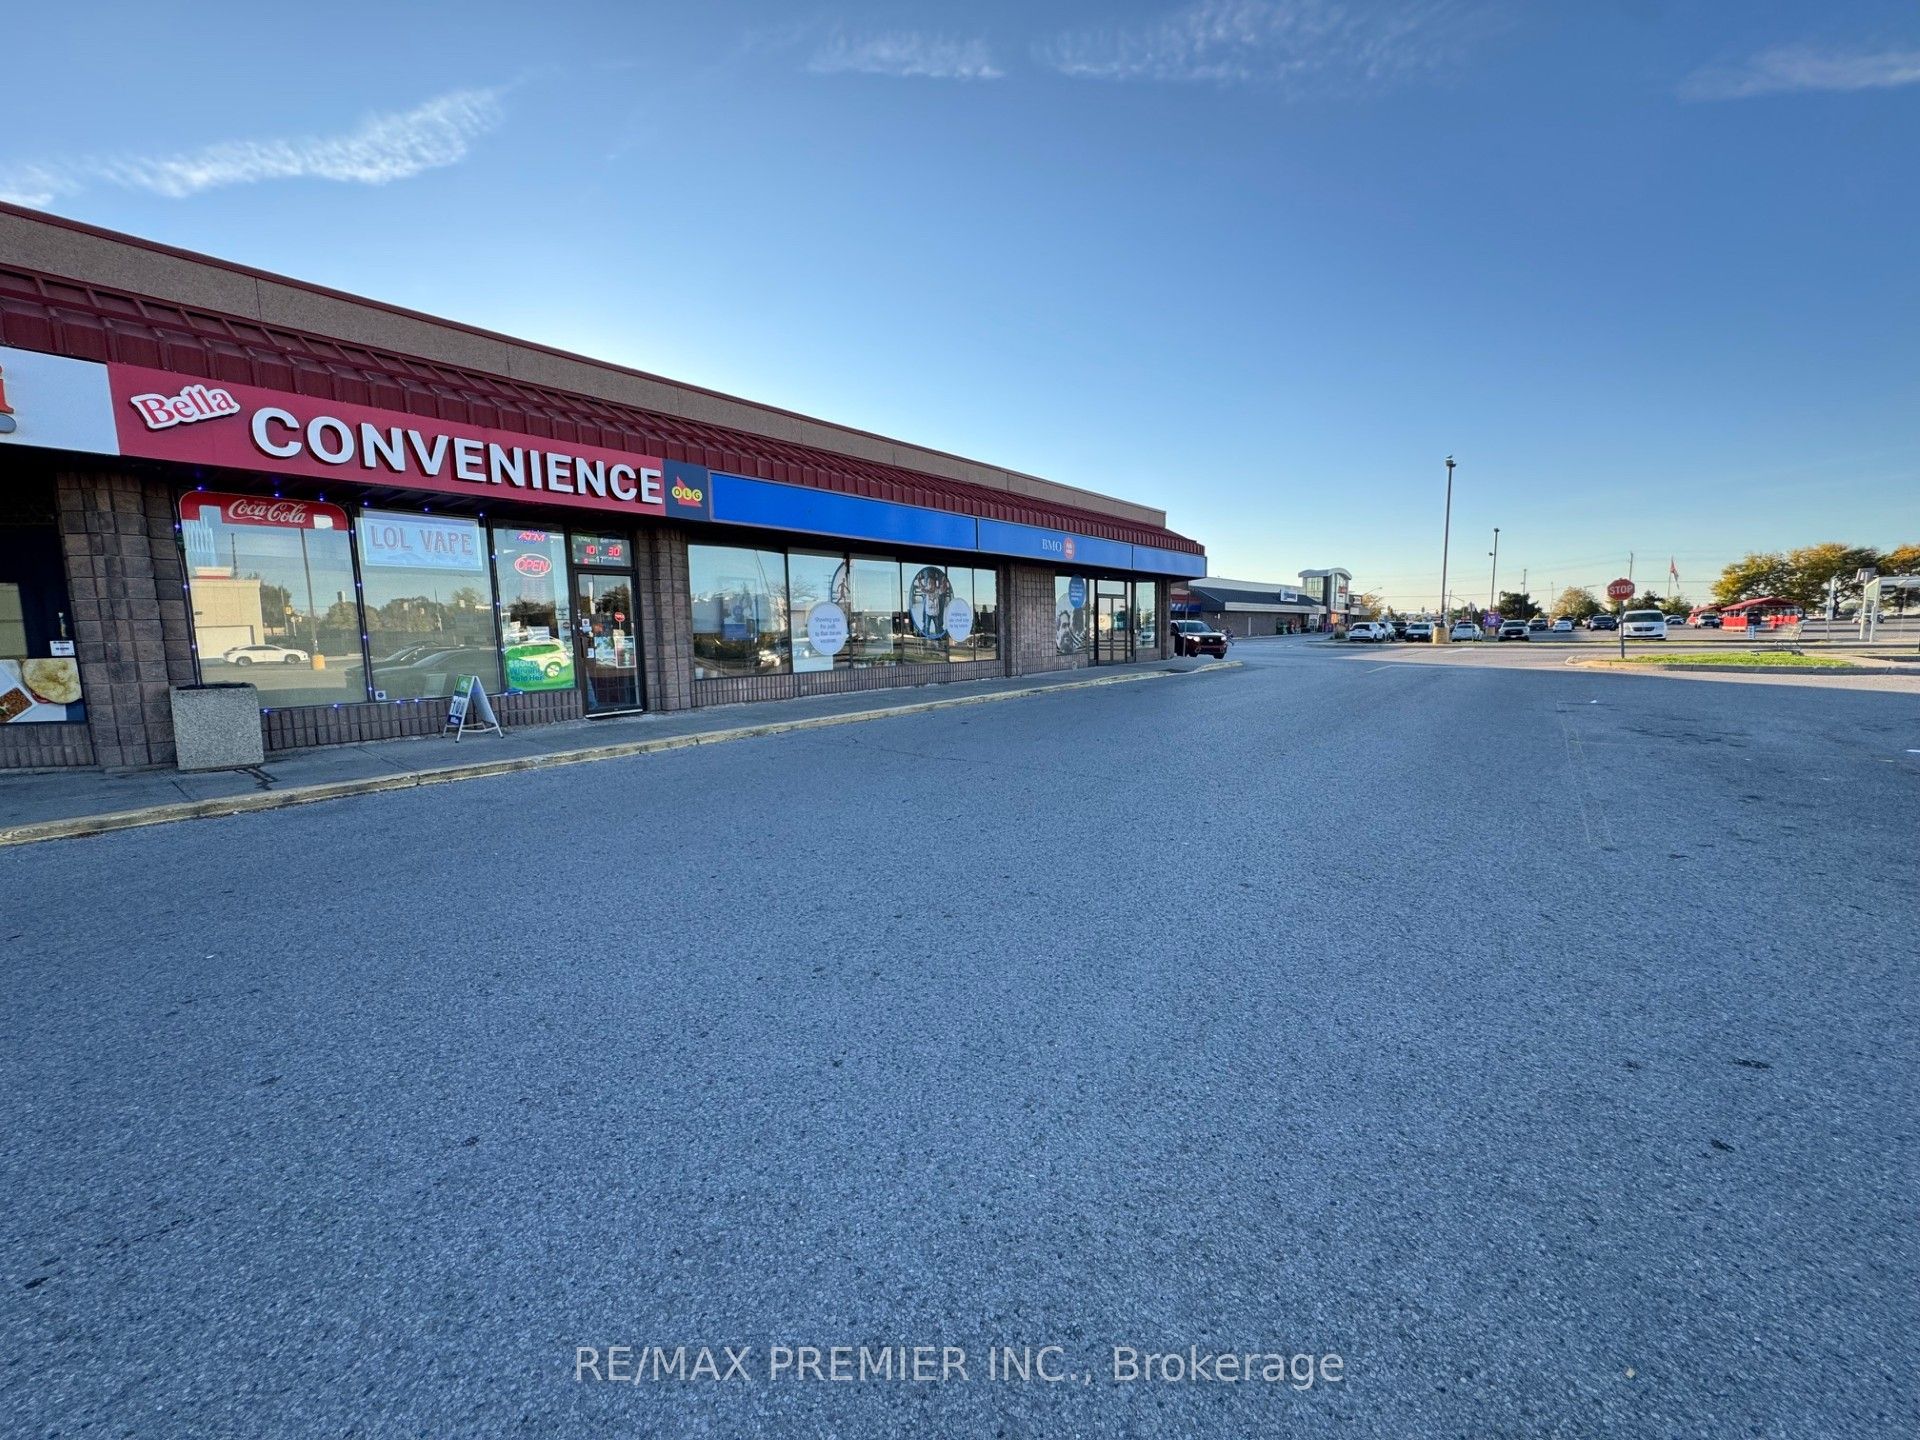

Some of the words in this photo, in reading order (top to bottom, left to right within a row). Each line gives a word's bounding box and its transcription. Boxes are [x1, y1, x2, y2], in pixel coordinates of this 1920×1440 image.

[135, 387, 238, 428] Bella
[251, 406, 663, 504] CONVENIENCE
[672, 486, 702, 501] OLG
[228, 499, 308, 523] Coca-Cola
[370, 525, 412, 550] LOL
[420, 529, 473, 556] VAPE
[518, 531, 545, 542] ATM
[1042, 538, 1062, 552] BMO
[517, 559, 549, 571] OPEN
[1610, 585, 1633, 595] STOP
